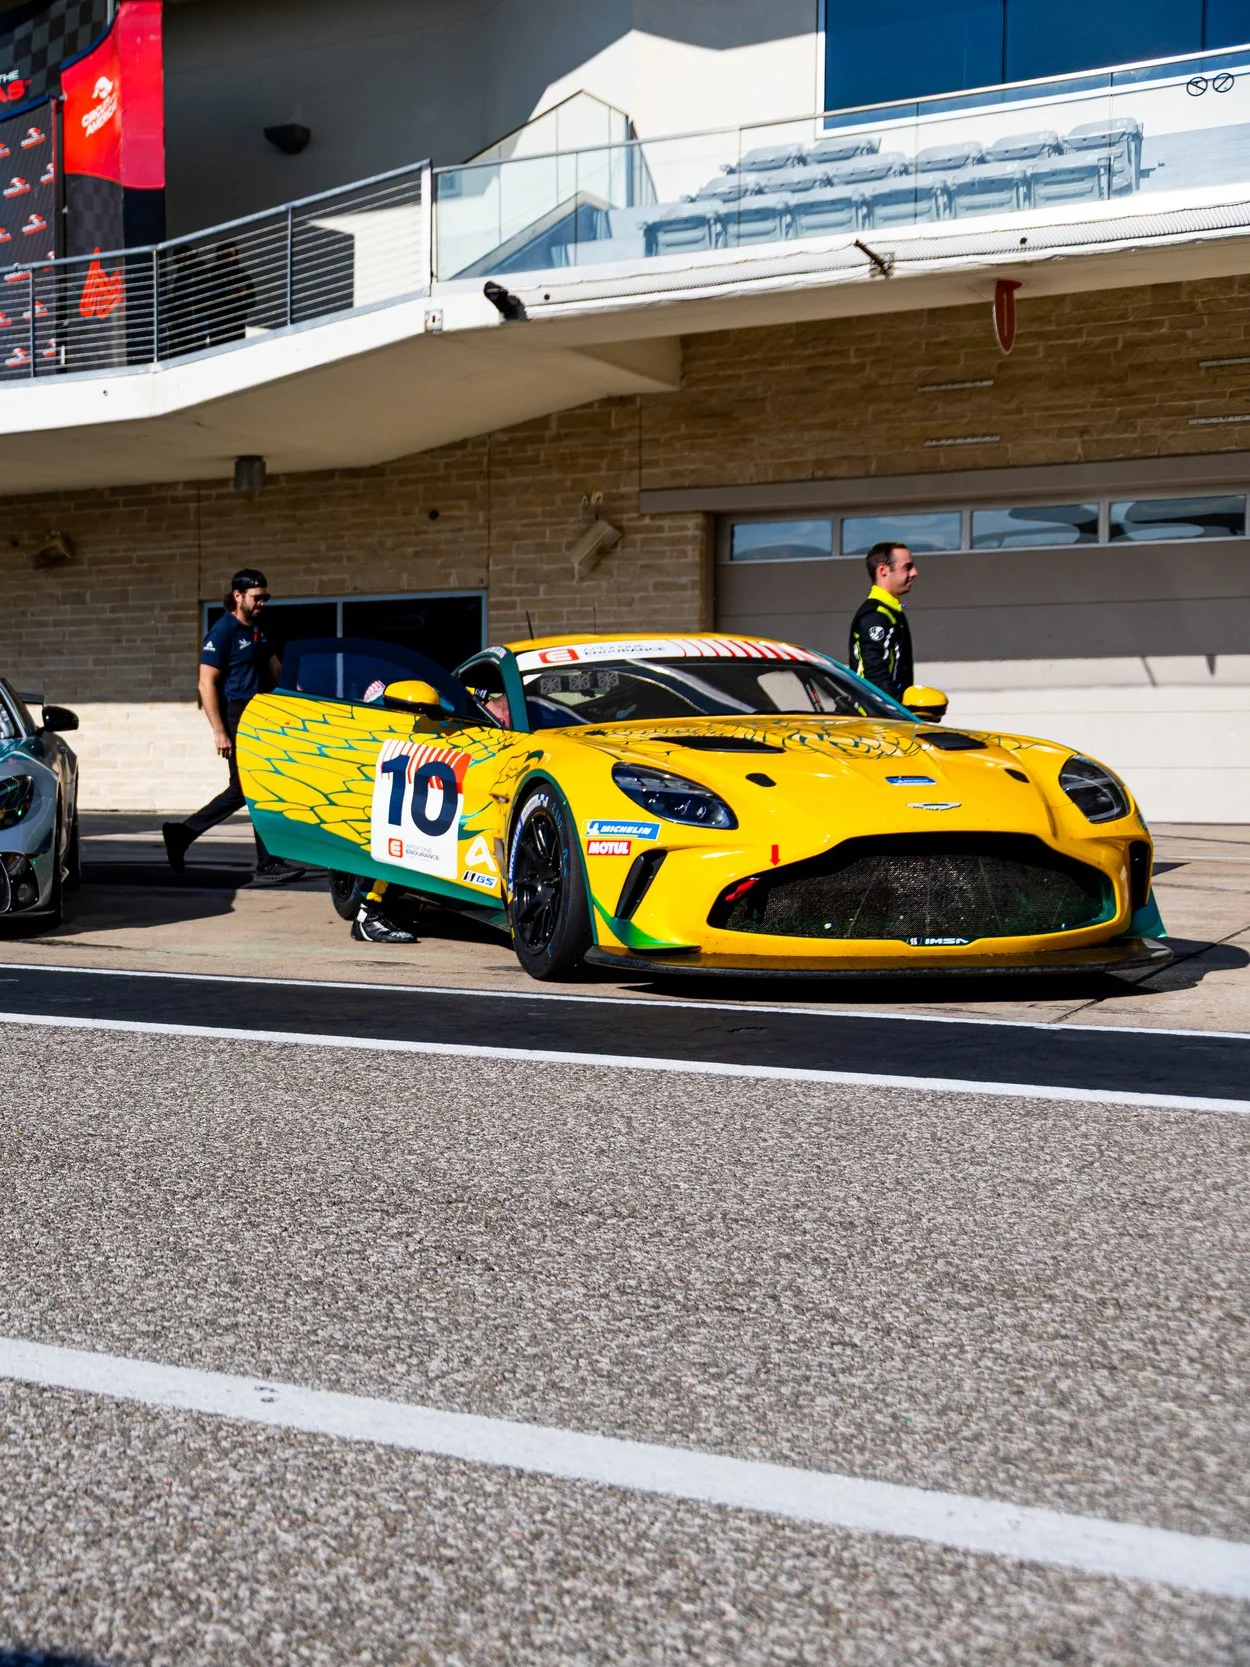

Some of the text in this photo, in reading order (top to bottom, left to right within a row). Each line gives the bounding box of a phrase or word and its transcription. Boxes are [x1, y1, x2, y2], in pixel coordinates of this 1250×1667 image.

[381, 754, 459, 837] 10
[600, 825, 653, 835] MICHELIN
[587, 841, 629, 855] MOTUL
[476, 875, 496, 886] GS
[924, 937, 970, 945] IMSA
